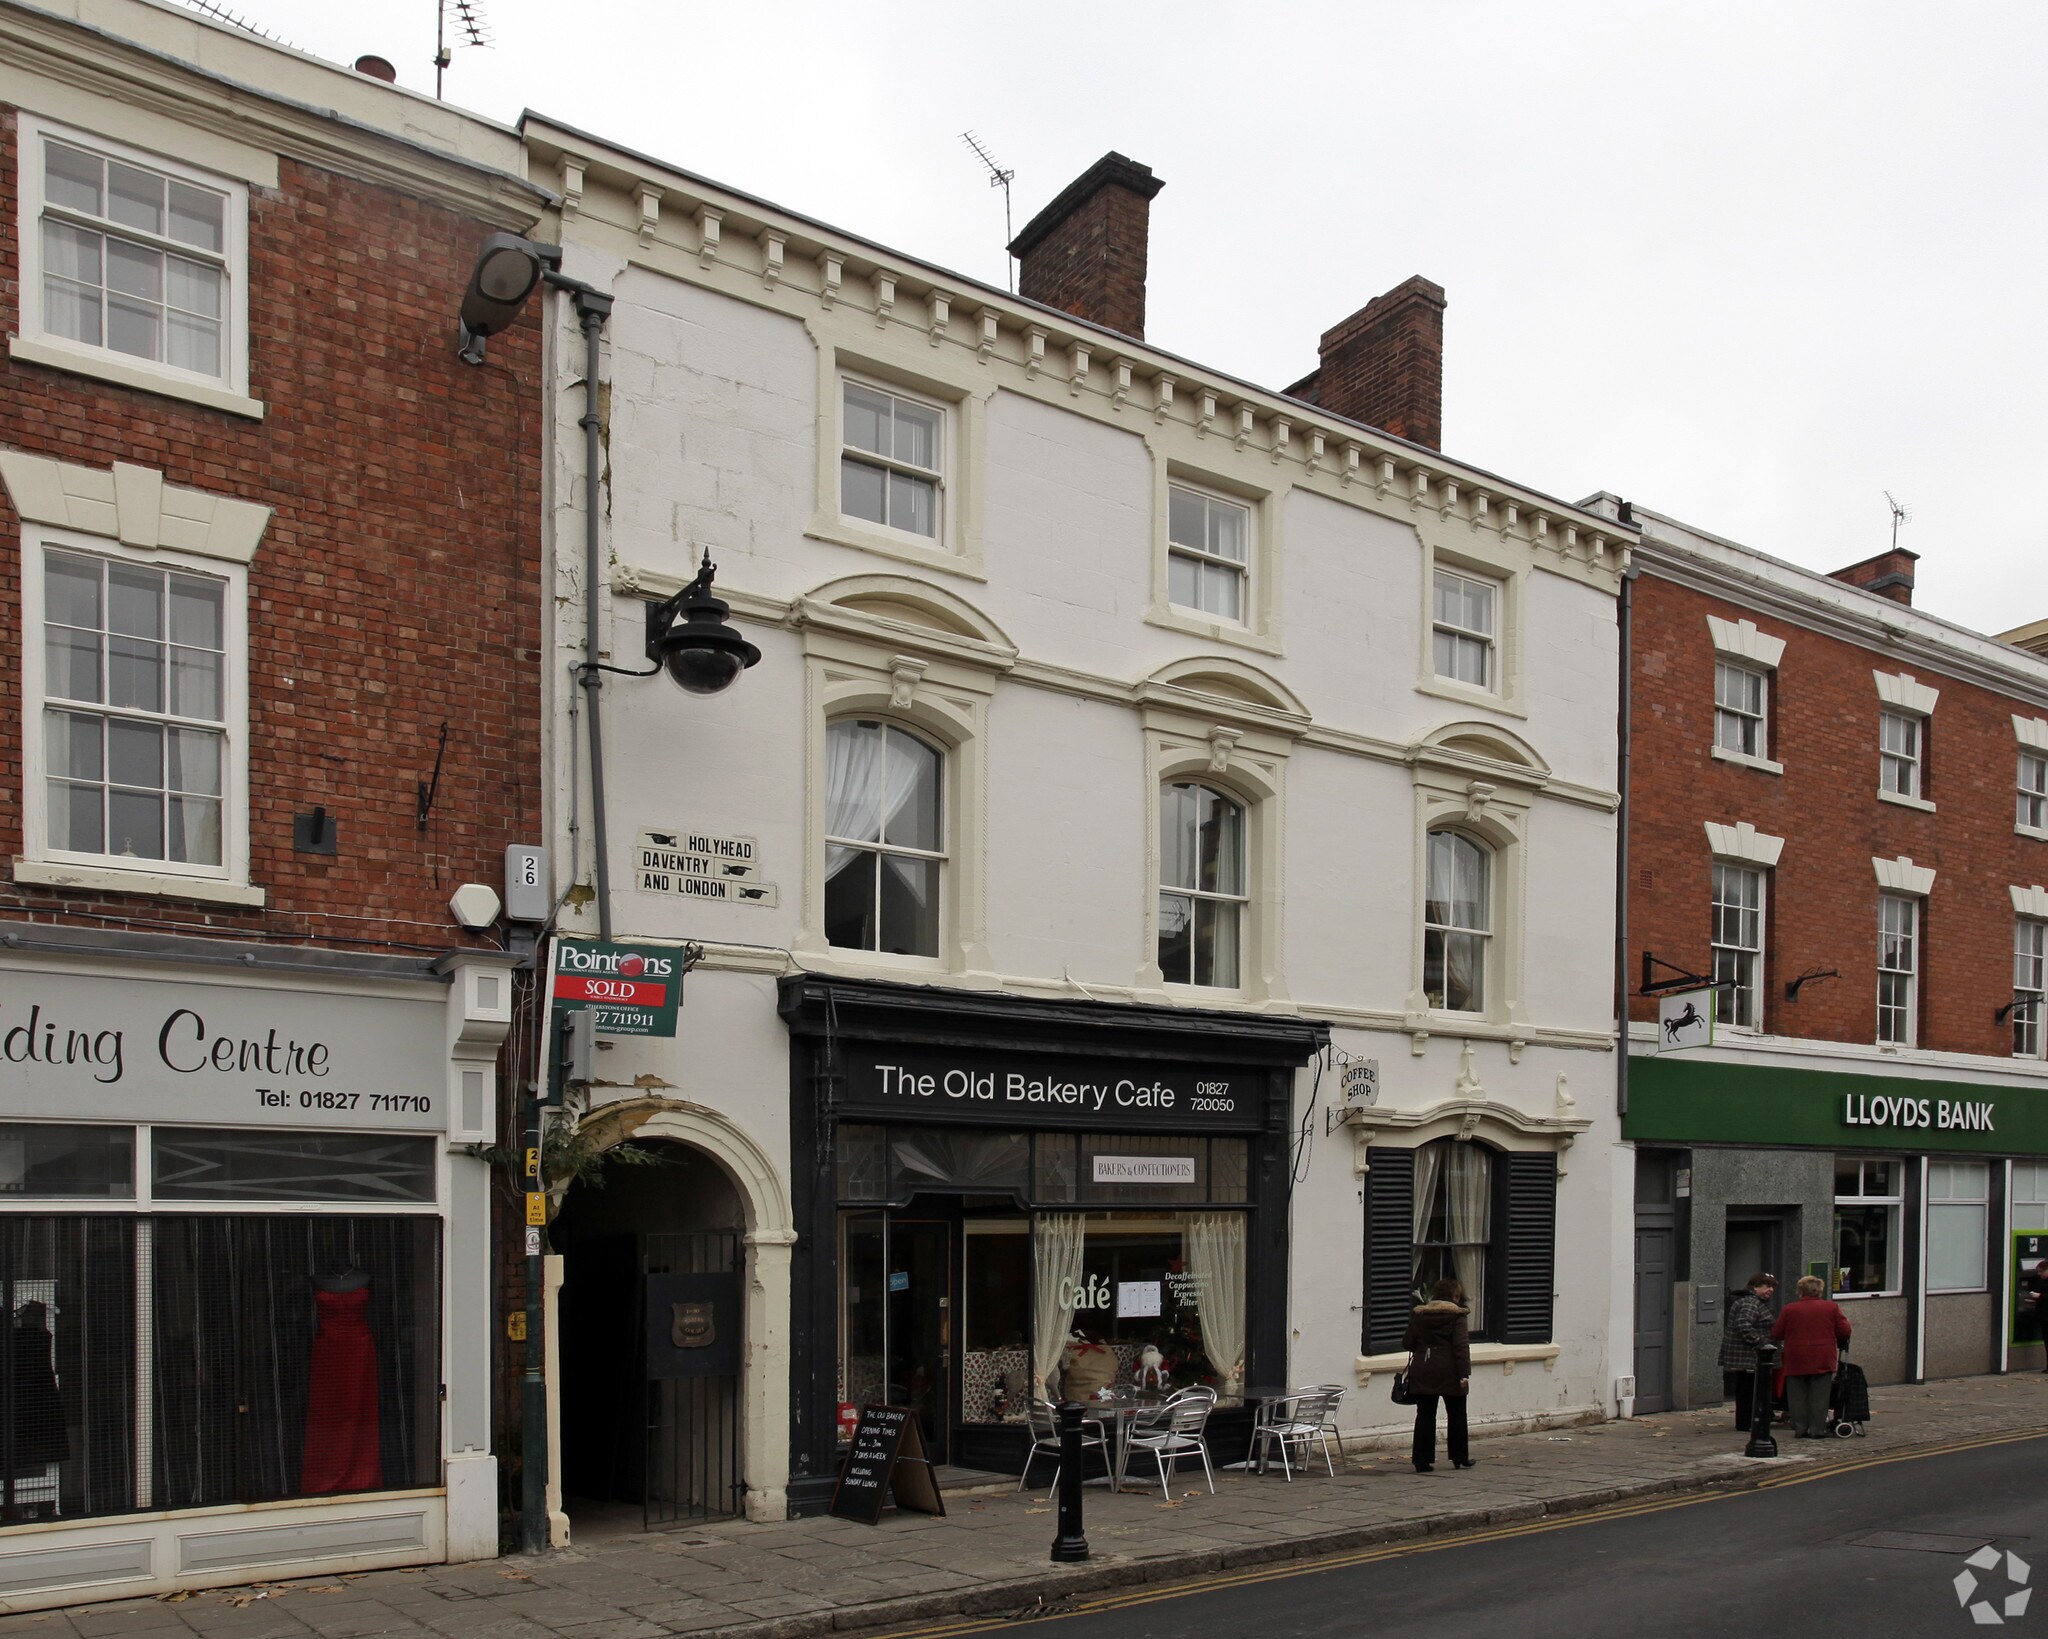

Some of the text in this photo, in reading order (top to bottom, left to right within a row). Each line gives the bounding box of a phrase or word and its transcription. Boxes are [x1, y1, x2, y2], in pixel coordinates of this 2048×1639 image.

[689, 836, 752, 858] HOLYHEAD
[643, 851, 709, 874] DAVENTRY
[644, 873, 726, 898] AND LONDON
[585, 980, 635, 998] SOLD
[612, 1012, 654, 1026] 711911
[0, 1003, 330, 1083] ding Centre
[875, 1065, 1175, 1110] The Old Bakery Cafe
[1341, 1067, 1376, 1088] COFFEE
[1196, 1081, 1230, 1096] 01827
[1347, 1083, 1372, 1102] SHOP
[256, 1088, 431, 1113] Tel: 01827 711710
[1190, 1097, 1235, 1112] 720050
[1846, 1093, 1995, 1131] LLOYDS BANK
[1098, 1163, 1191, 1177] BAKERS & CONFECTIONERS
[1058, 1273, 1111, 1310] Café
[1169, 1281, 1209, 1290] Cappuccino
[867, 1411, 905, 1421] THE OLD BAKERY
[882, 1428, 896, 1436] TIMES
